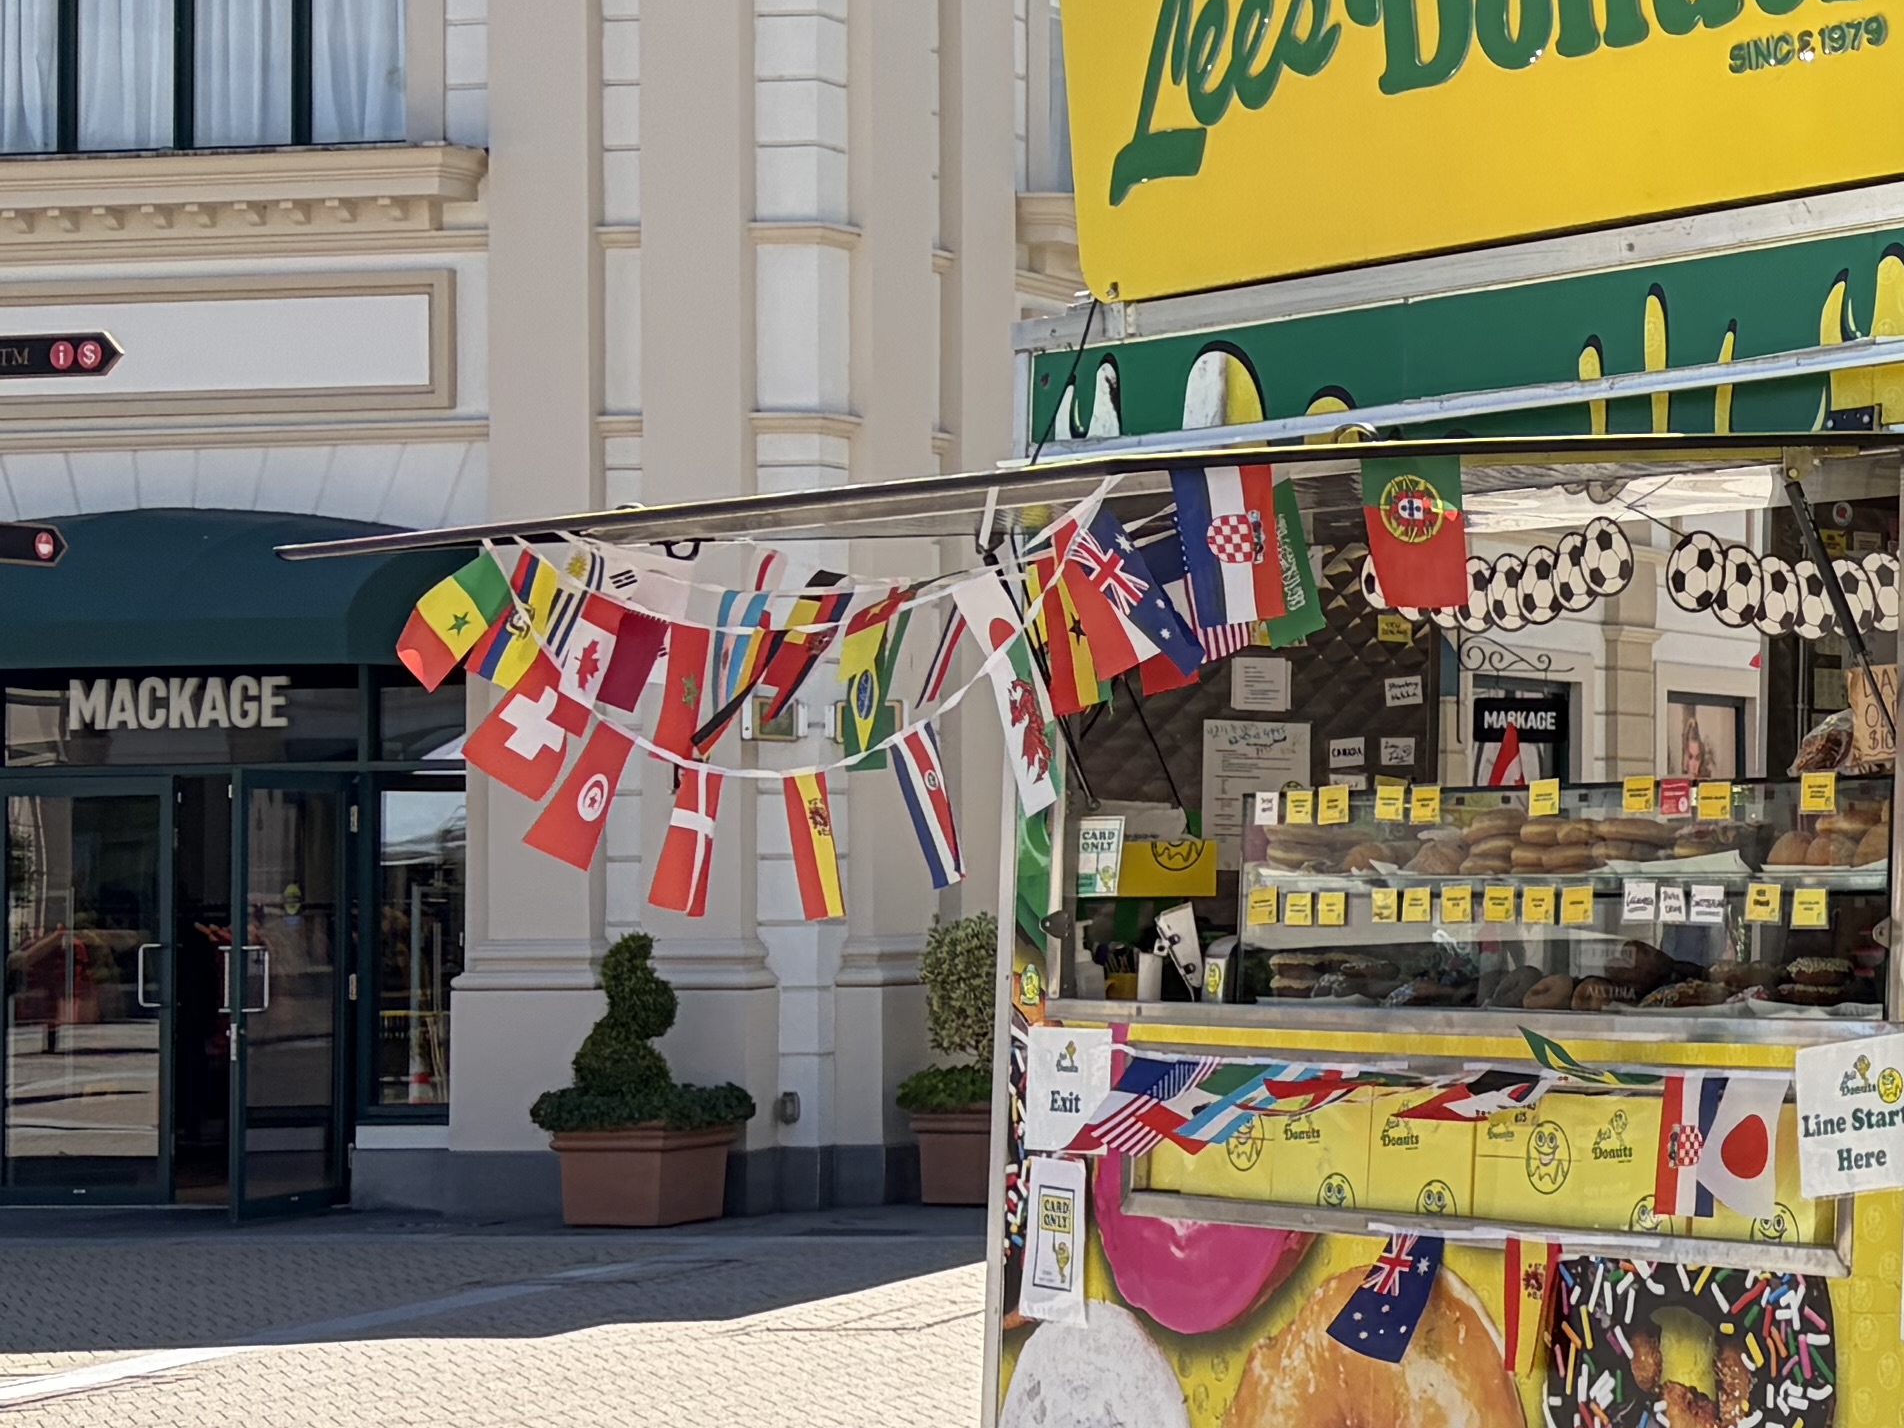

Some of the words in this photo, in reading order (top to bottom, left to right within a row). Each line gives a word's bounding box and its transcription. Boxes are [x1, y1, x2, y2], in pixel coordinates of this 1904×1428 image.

[1729, 30, 1816, 73] SINCE
[1818, 15, 1888, 56] 1979
[69, 675, 291, 730] MACKAGE
[1082, 831, 1115, 841] CARD
[1082, 841, 1114, 851] ONLY
[1050, 1090, 1081, 1113] Exit
[1802, 1113, 1847, 1138] Line
[1592, 1146, 1633, 1160] Donuts
[1837, 1148, 1887, 1172] Here
[1044, 1199, 1069, 1213] CARD
[1043, 1214, 1067, 1228] ONLY
